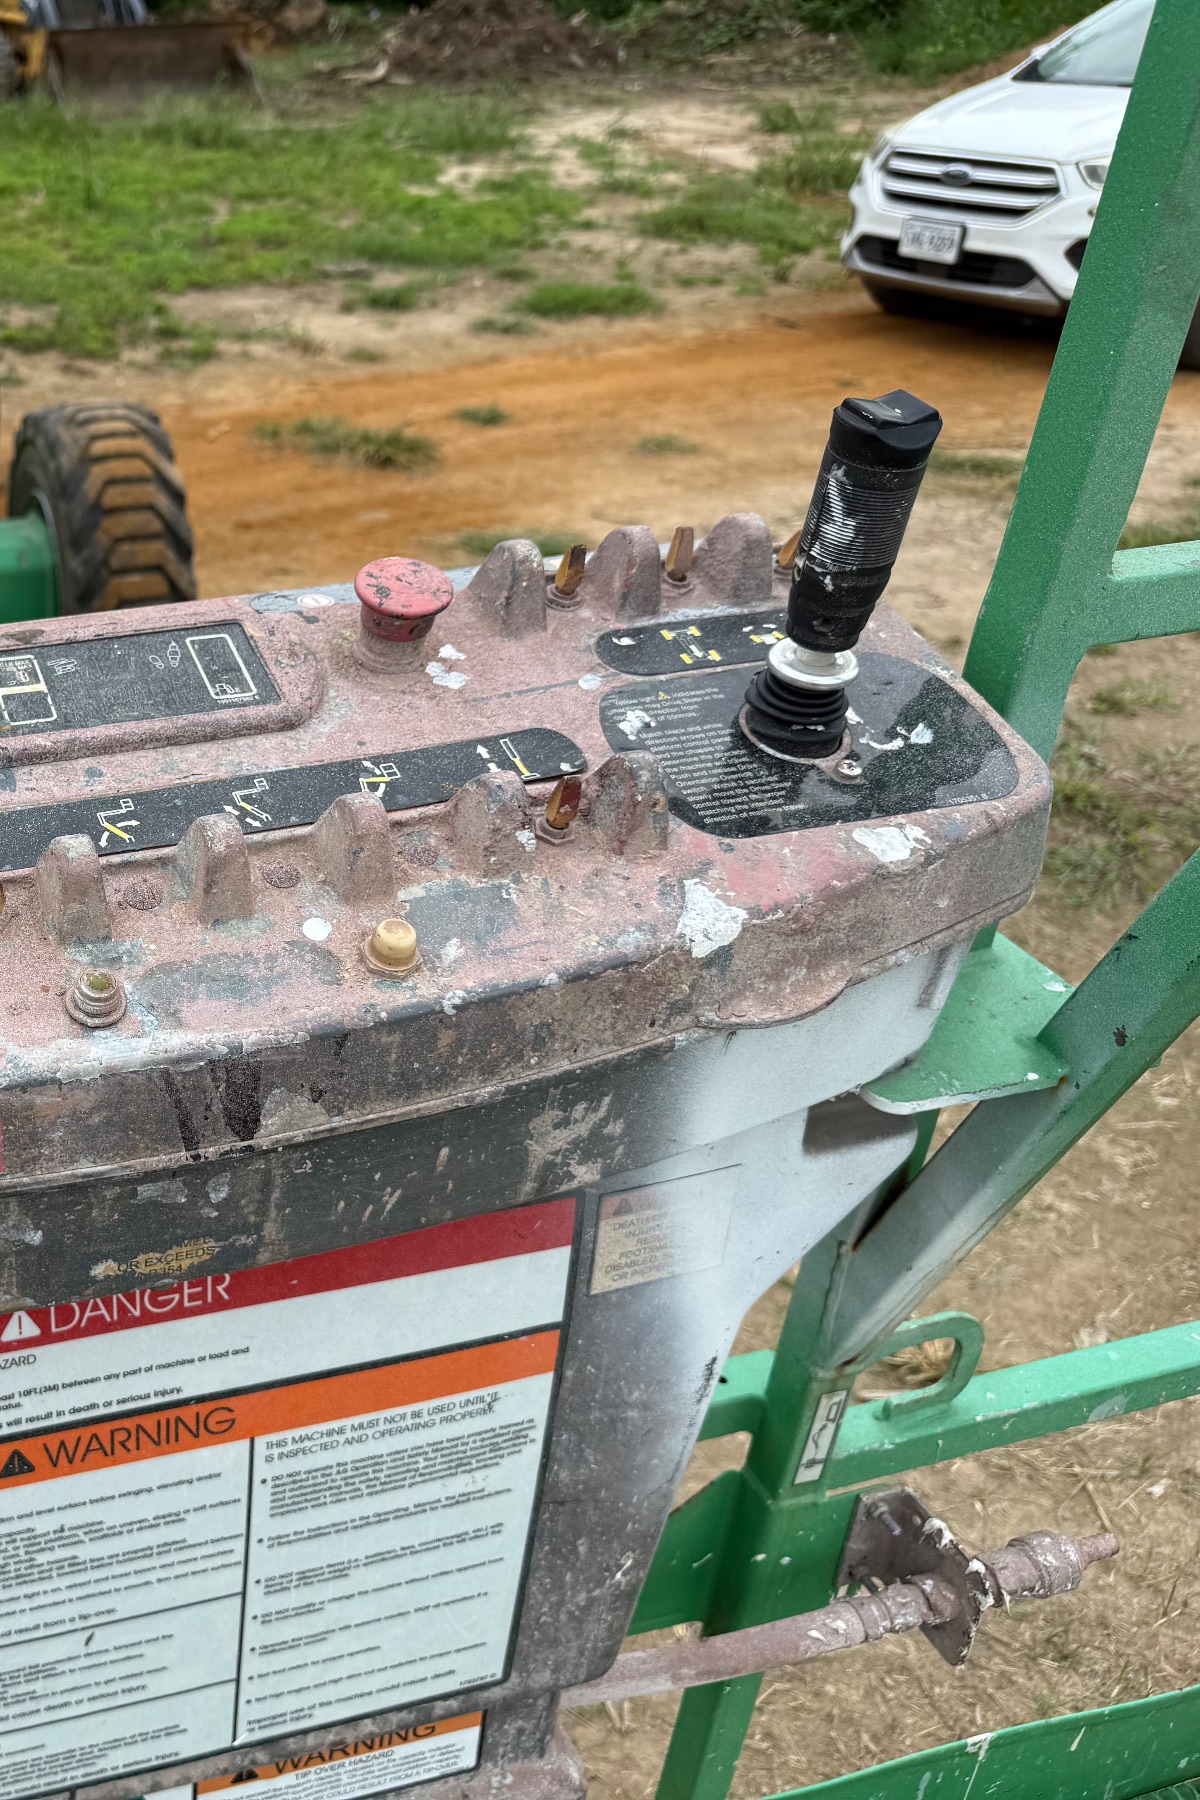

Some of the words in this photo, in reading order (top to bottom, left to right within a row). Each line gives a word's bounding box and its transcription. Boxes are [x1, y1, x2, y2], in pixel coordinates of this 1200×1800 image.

[650, 744, 682, 752] platform
[660, 756, 698, 766] determine
[679, 762, 712, 770] machine
[708, 766, 737, 774] release
[675, 776, 719, 787] Orientation
[719, 771, 753, 780] Override
[692, 800, 720, 808] control
[721, 796, 748, 804] toward
[698, 806, 735, 816] matching
[703, 814, 738, 823] direction
[118, 1260, 139, 1272] OR
[145, 1248, 216, 1266] EXCEEDS
[606, 1255, 656, 1273] DISABLED
[50, 1273, 230, 1333] DANGER
[61, 1376, 101, 1389] between
[103, 1372, 120, 1380] any
[123, 1367, 142, 1378] part
[144, 1364, 153, 1372] of
[155, 1358, 195, 1370] machine
[208, 1350, 229, 1360] load
[231, 1346, 249, 1356] and
[6, 1417, 22, 1427] will
[25, 1411, 53, 1423] result
[68, 1402, 99, 1414] death
[116, 1393, 151, 1405] serious
[154, 1386, 182, 1397] injury.
[43, 1406, 236, 1467] WARNING
[264, 1436, 288, 1451] THIS
[291, 1425, 346, 1445] MACHINE
[350, 1418, 379, 1432] MUST
[383, 1412, 406, 1425] NOT
[410, 1409, 423, 1419] BE
[427, 1402, 456, 1416] USED
[265, 1453, 274, 1463] IS
[277, 1439, 340, 1460] INSPECTED
[342, 1433, 369, 1446] AND
[371, 1418, 436, 1440] OPERATING
[16, 1511, 34, 1520] and
[35, 1506, 55, 1516] level
[56, 1501, 87, 1511] surface
[89, 1495, 116, 1504] before
[156, 1478, 194, 1490] elevating
[195, 1472, 221, 1482] and/or
[294, 1769, 312, 1780] TIP
[314, 1762, 346, 1775] OVER
[348, 1749, 395, 1767] HAZARD
